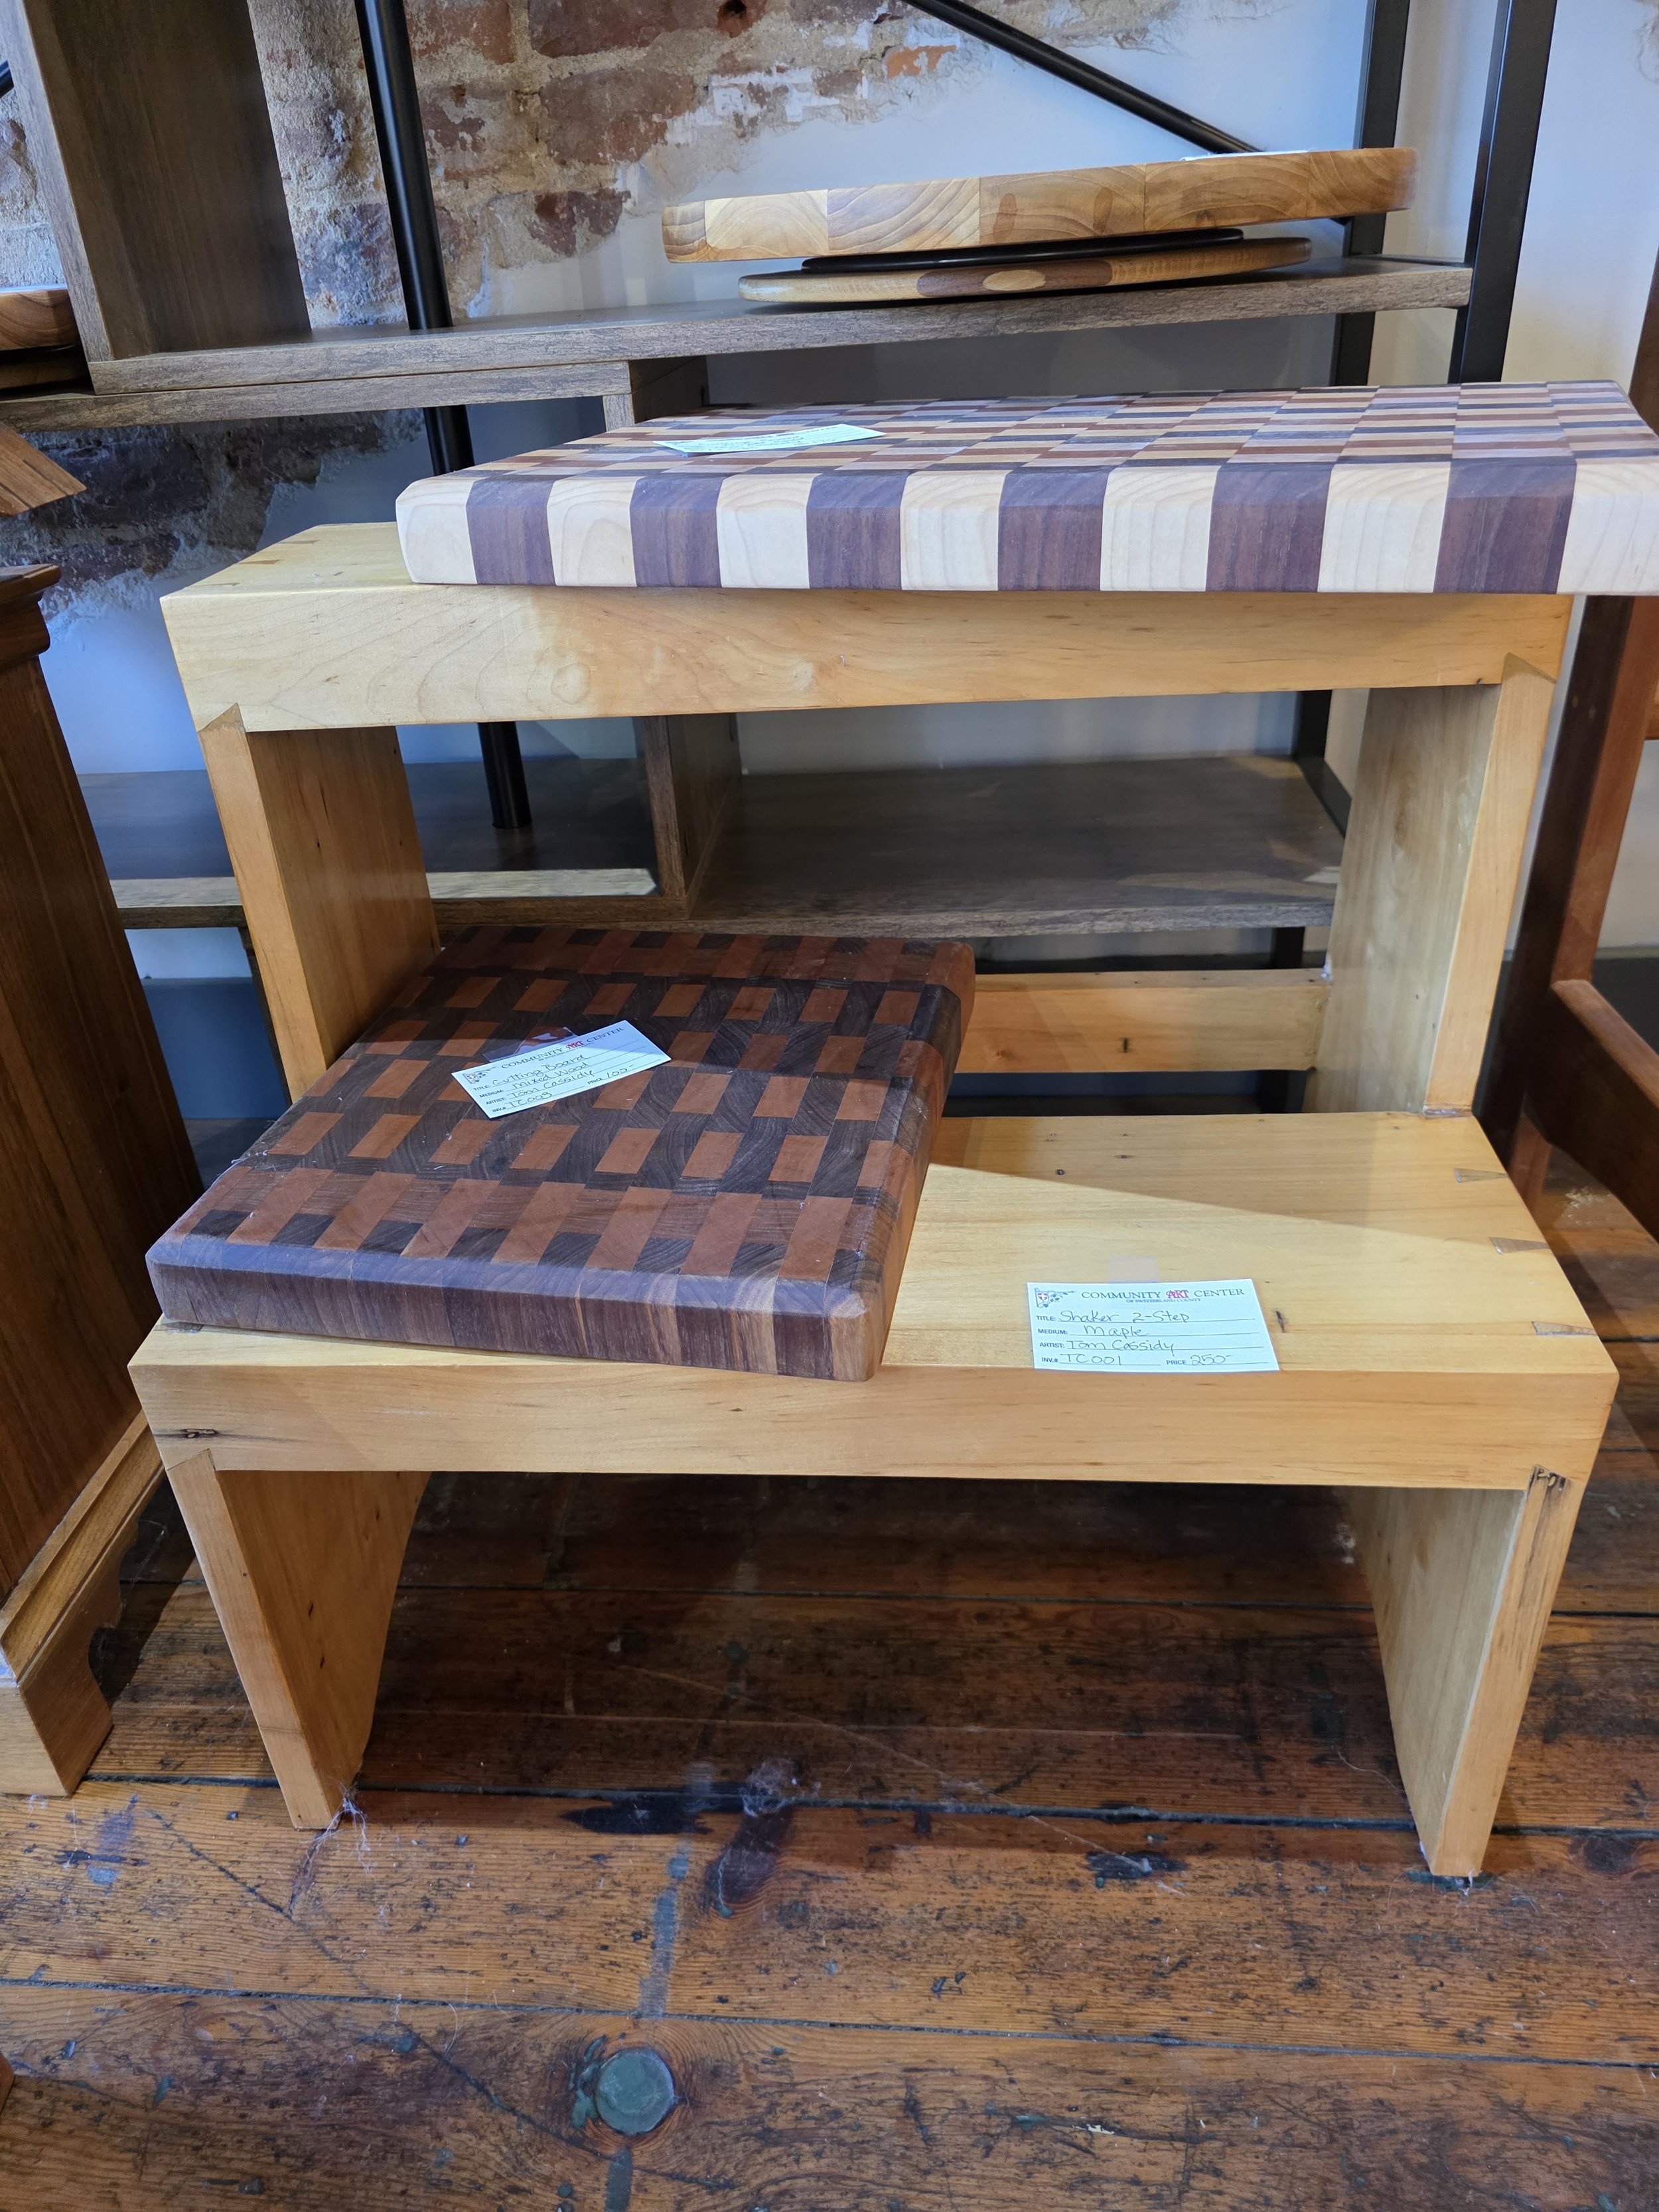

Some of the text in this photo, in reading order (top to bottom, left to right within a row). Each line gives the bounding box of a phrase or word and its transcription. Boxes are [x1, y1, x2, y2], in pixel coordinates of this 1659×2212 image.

[501, 1047, 563, 1069] COMMUNITY
[566, 1040, 585, 1050] ART
[587, 1027, 624, 1043] CENTER
[479, 1089, 505, 1098] MEDIUM:
[555, 1062, 591, 1077] Wood
[492, 1069, 545, 1085] Cutting
[541, 1054, 591, 1071] Board
[486, 1070, 594, 1105] ARTIST: Tom Cassidy
[1166, 1290, 1190, 1299] ART
[1194, 1288, 1246, 1297] CENTER
[1132, 1310, 1190, 1323] 2-Step
[1066, 1340, 1106, 1350] Tom
[1112, 1339, 1175, 1357] Cassidy
